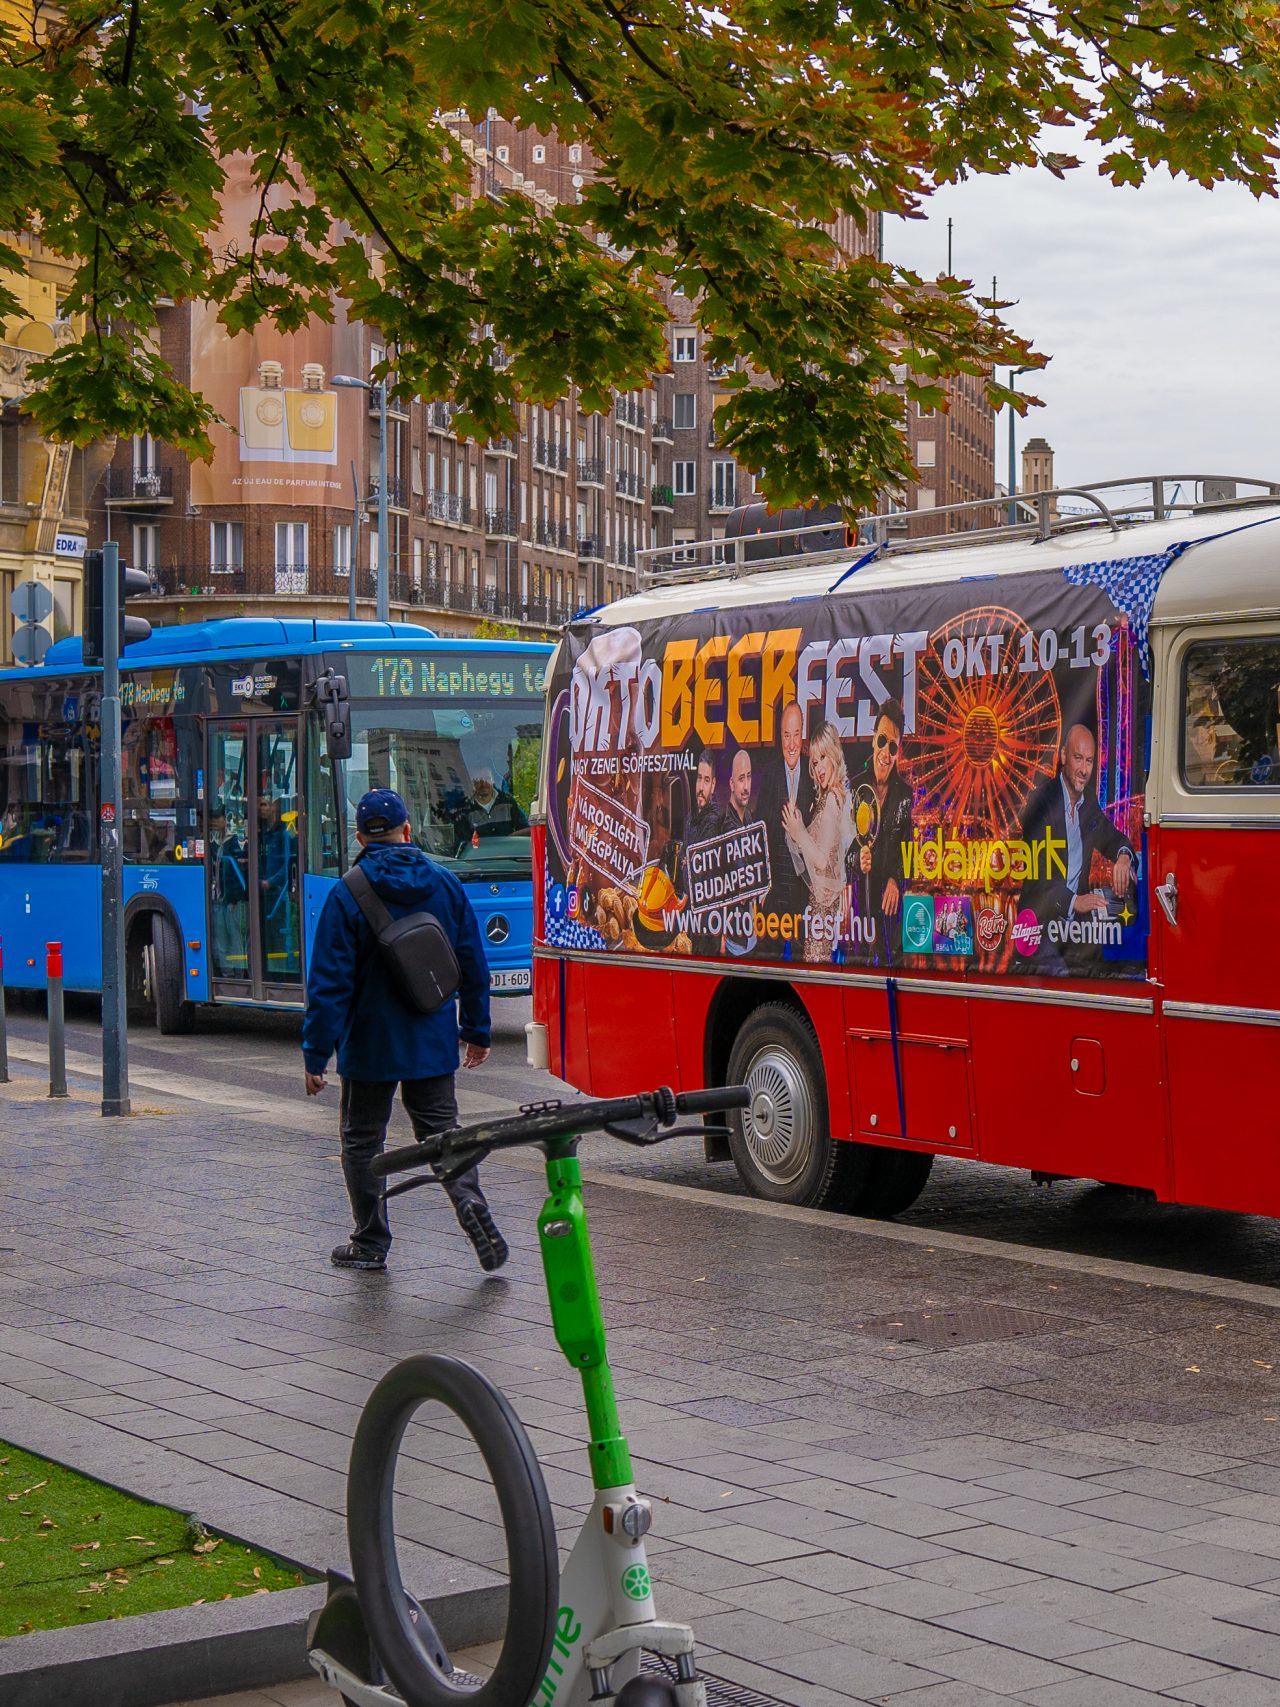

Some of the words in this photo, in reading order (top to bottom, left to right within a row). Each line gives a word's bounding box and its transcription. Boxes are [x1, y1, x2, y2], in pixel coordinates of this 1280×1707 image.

[286, 479, 318, 487] PARFUM
[943, 634, 1008, 679] OKT.
[1018, 623, 1112, 673] 10-13
[135, 682, 170, 704] Naphegy
[371, 658, 414, 696] 178
[421, 662, 514, 696] Naphegy
[522, 663, 545, 693] té
[590, 757, 619, 775] ZENEI
[622, 749, 697, 774] SÖRFESZTIVÁL
[692, 847, 722, 874] CITY
[725, 832, 762, 863] PARK
[901, 825, 1067, 893] vidámpark
[694, 861, 764, 903] BUDAPEST
[661, 900, 876, 943] www.oktobeerfest.hu
[1047, 918, 1123, 946] eventim
